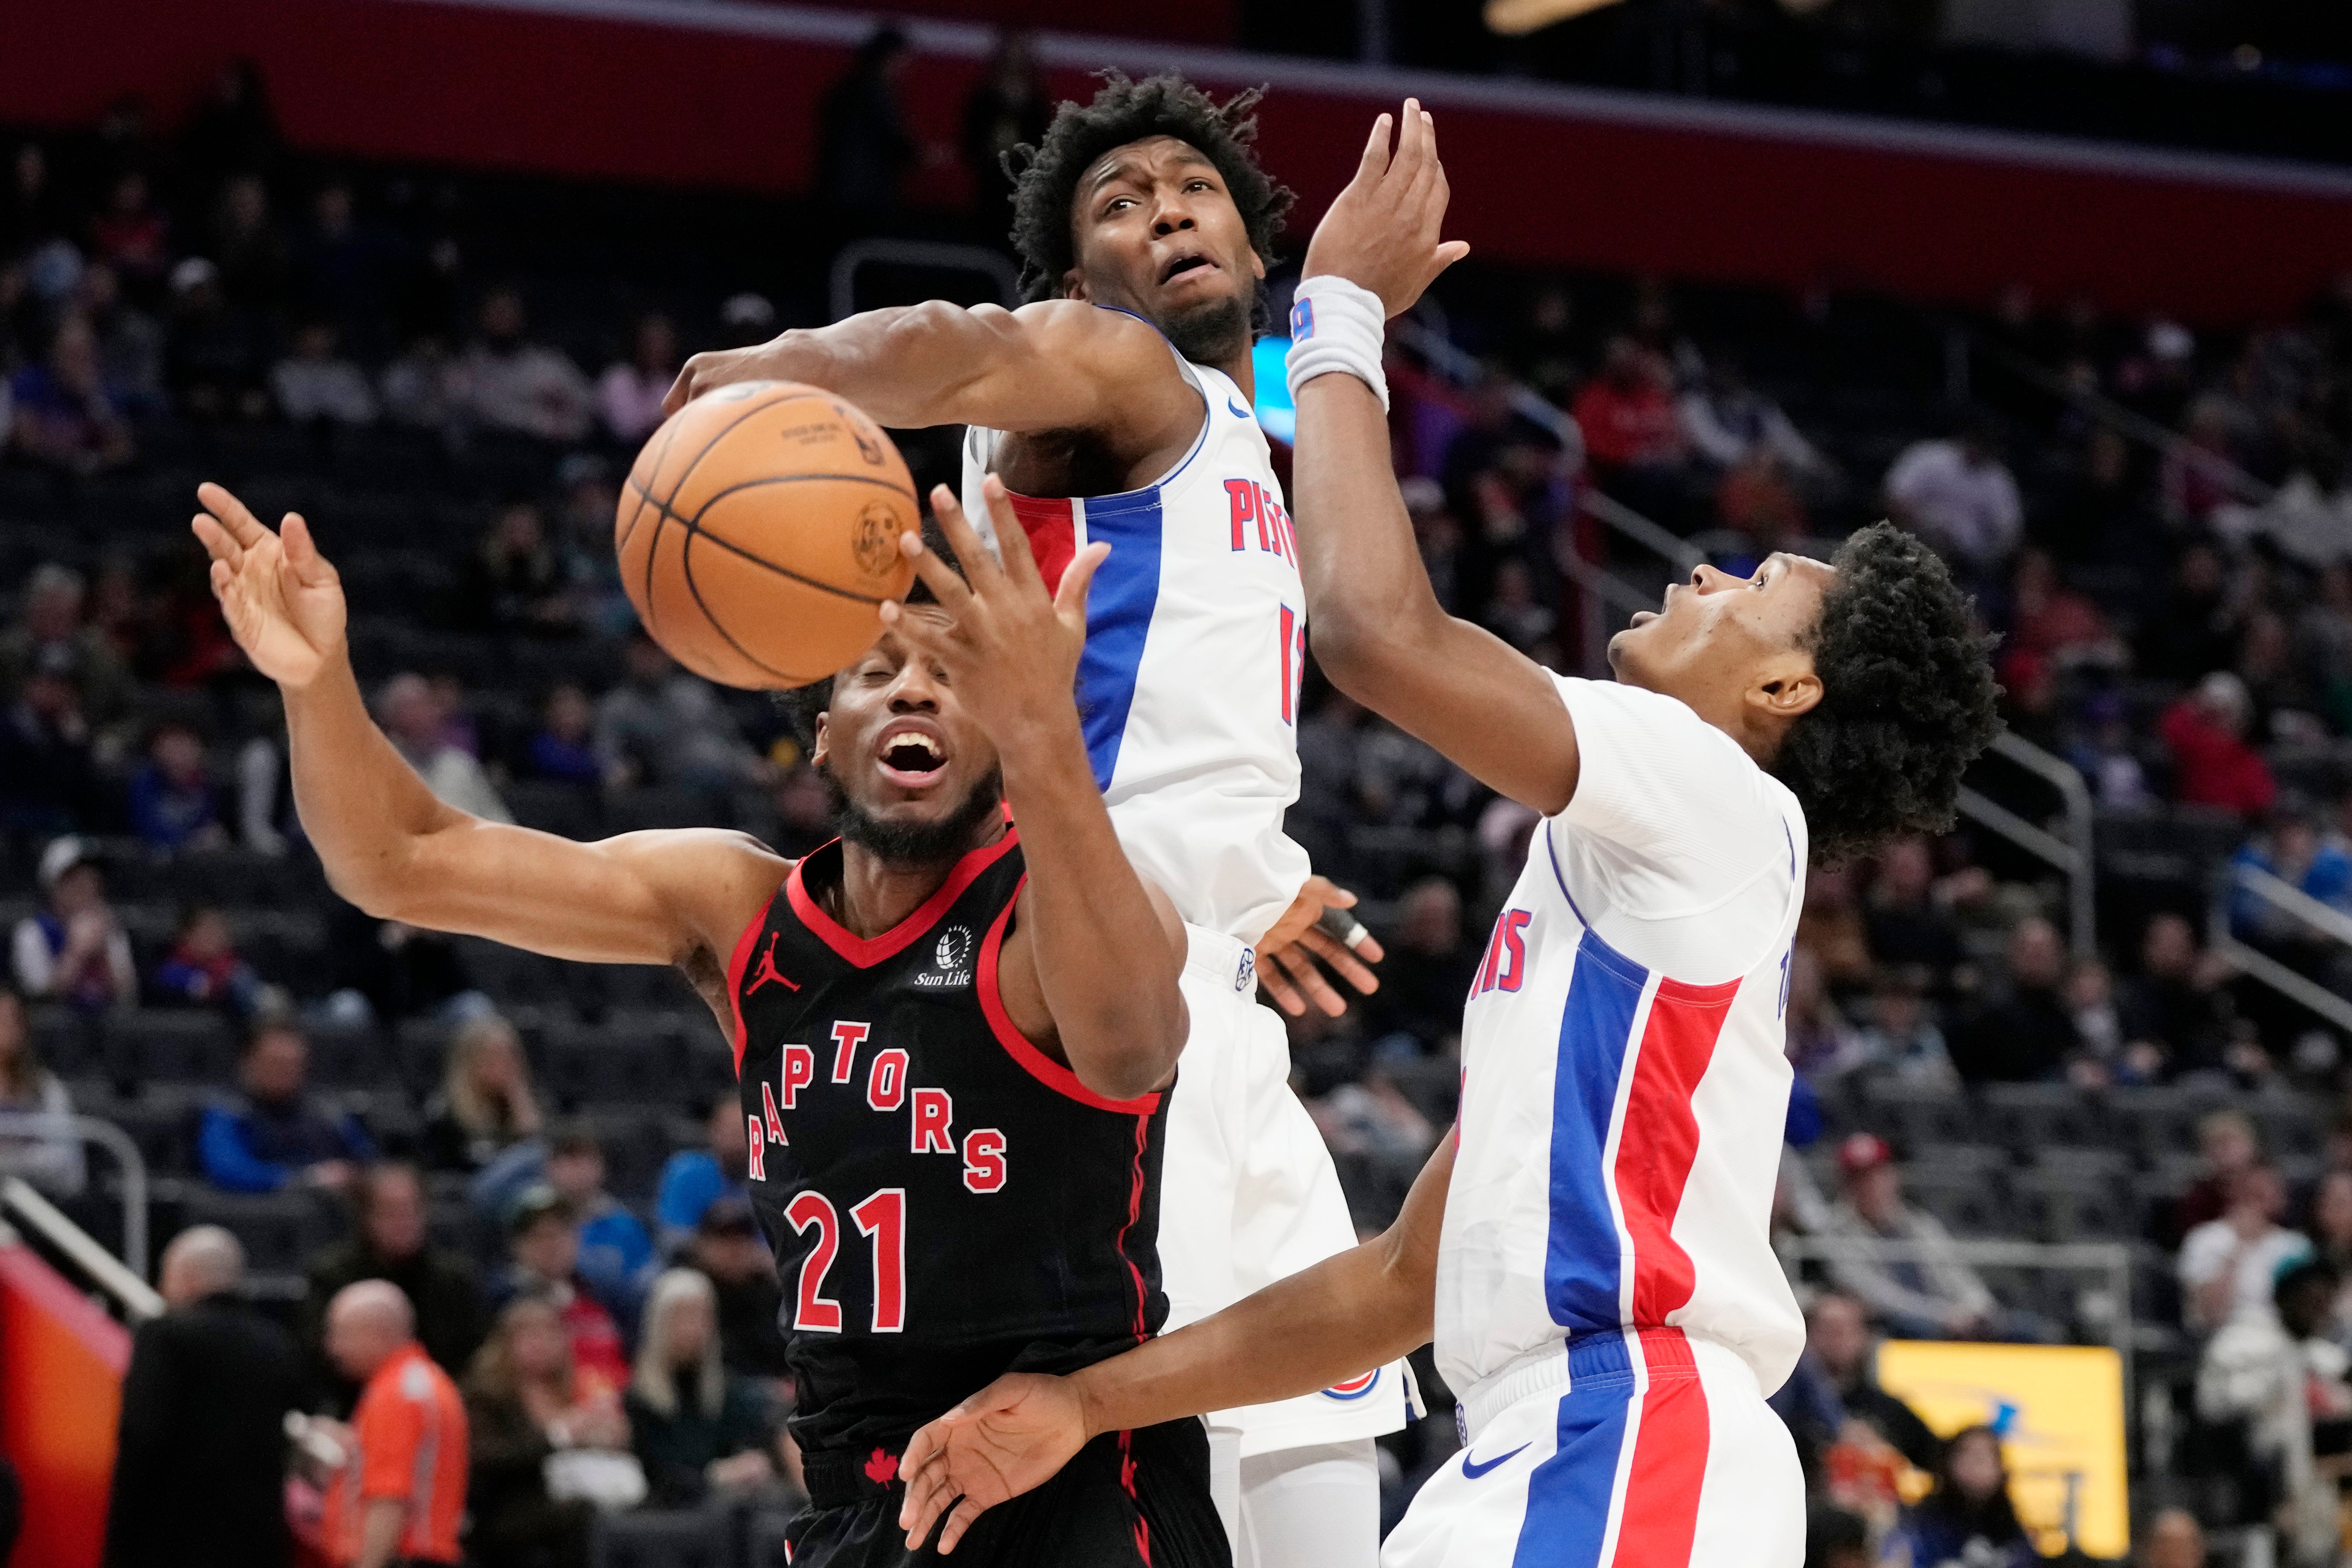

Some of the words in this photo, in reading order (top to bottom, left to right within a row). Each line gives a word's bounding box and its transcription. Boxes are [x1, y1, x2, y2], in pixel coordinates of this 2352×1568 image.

[914, 972, 943, 986] Sun
[945, 969, 970, 985] Life
[748, 1020, 1007, 1194] RAPTORS
[784, 1188, 906, 1333] 21
